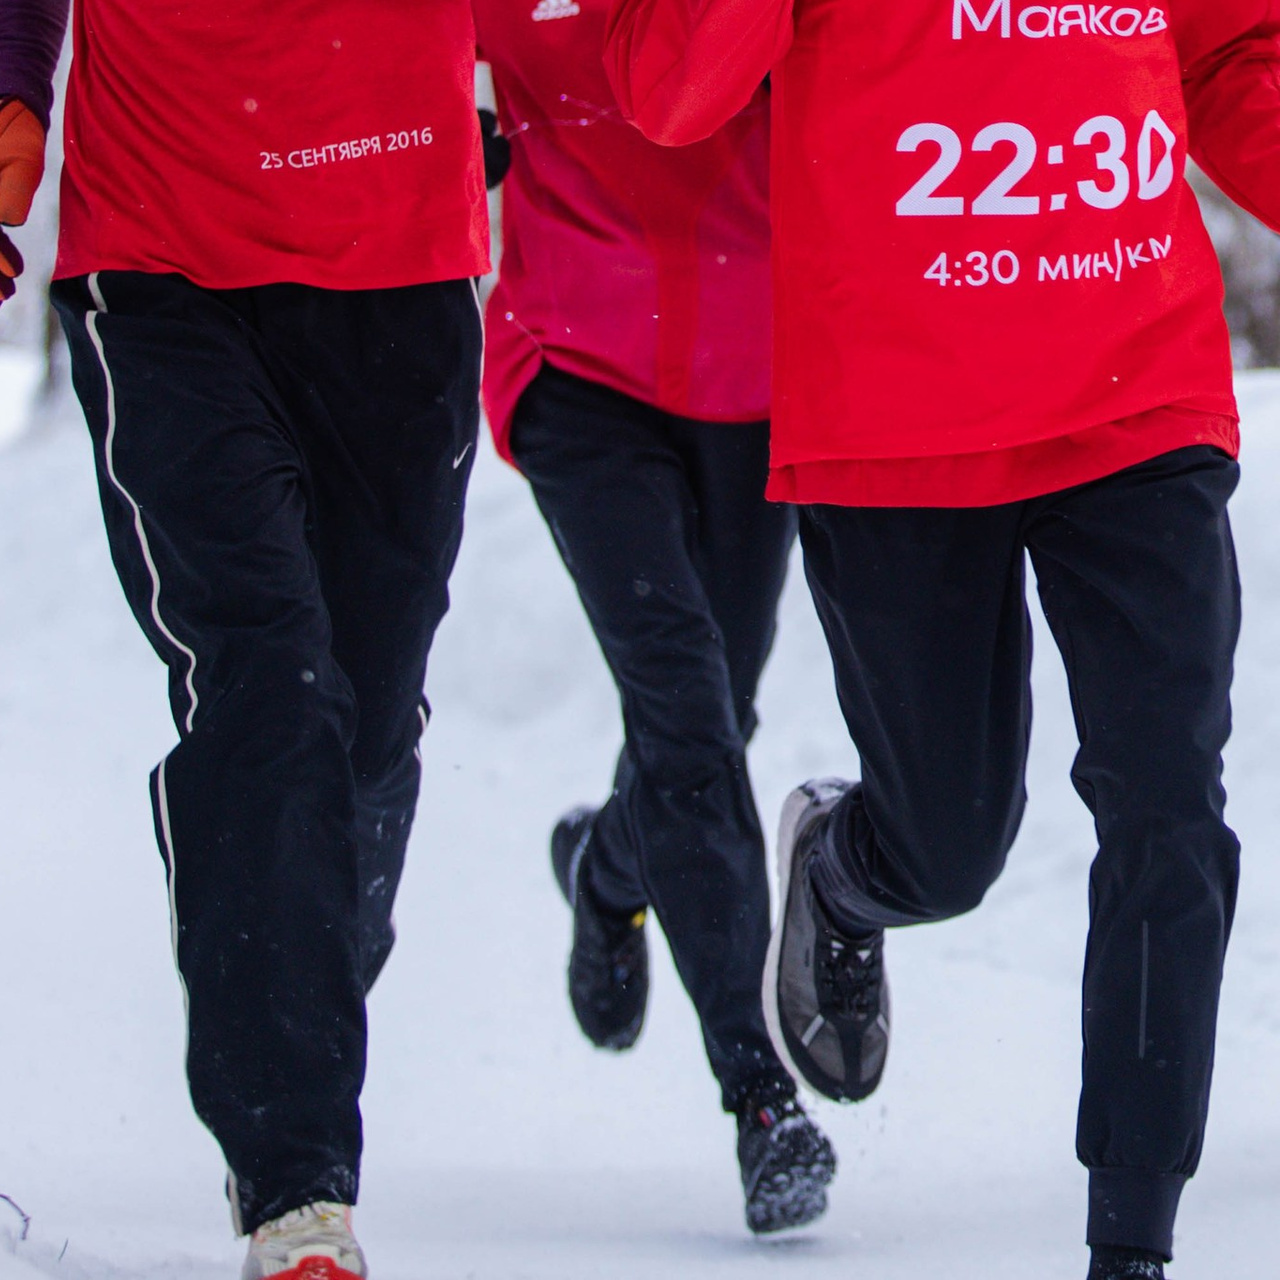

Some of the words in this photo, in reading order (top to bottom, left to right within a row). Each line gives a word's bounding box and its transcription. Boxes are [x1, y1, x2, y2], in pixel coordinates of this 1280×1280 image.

[259, 151, 284, 170] 25
[287, 135, 383, 169] СЕНТЯБРЯ
[386, 127, 434, 152] 2016
[895, 109, 1177, 216] 22:30
[923, 249, 1020, 287] 4:30
[1037, 234, 1172, 282] мин/км
